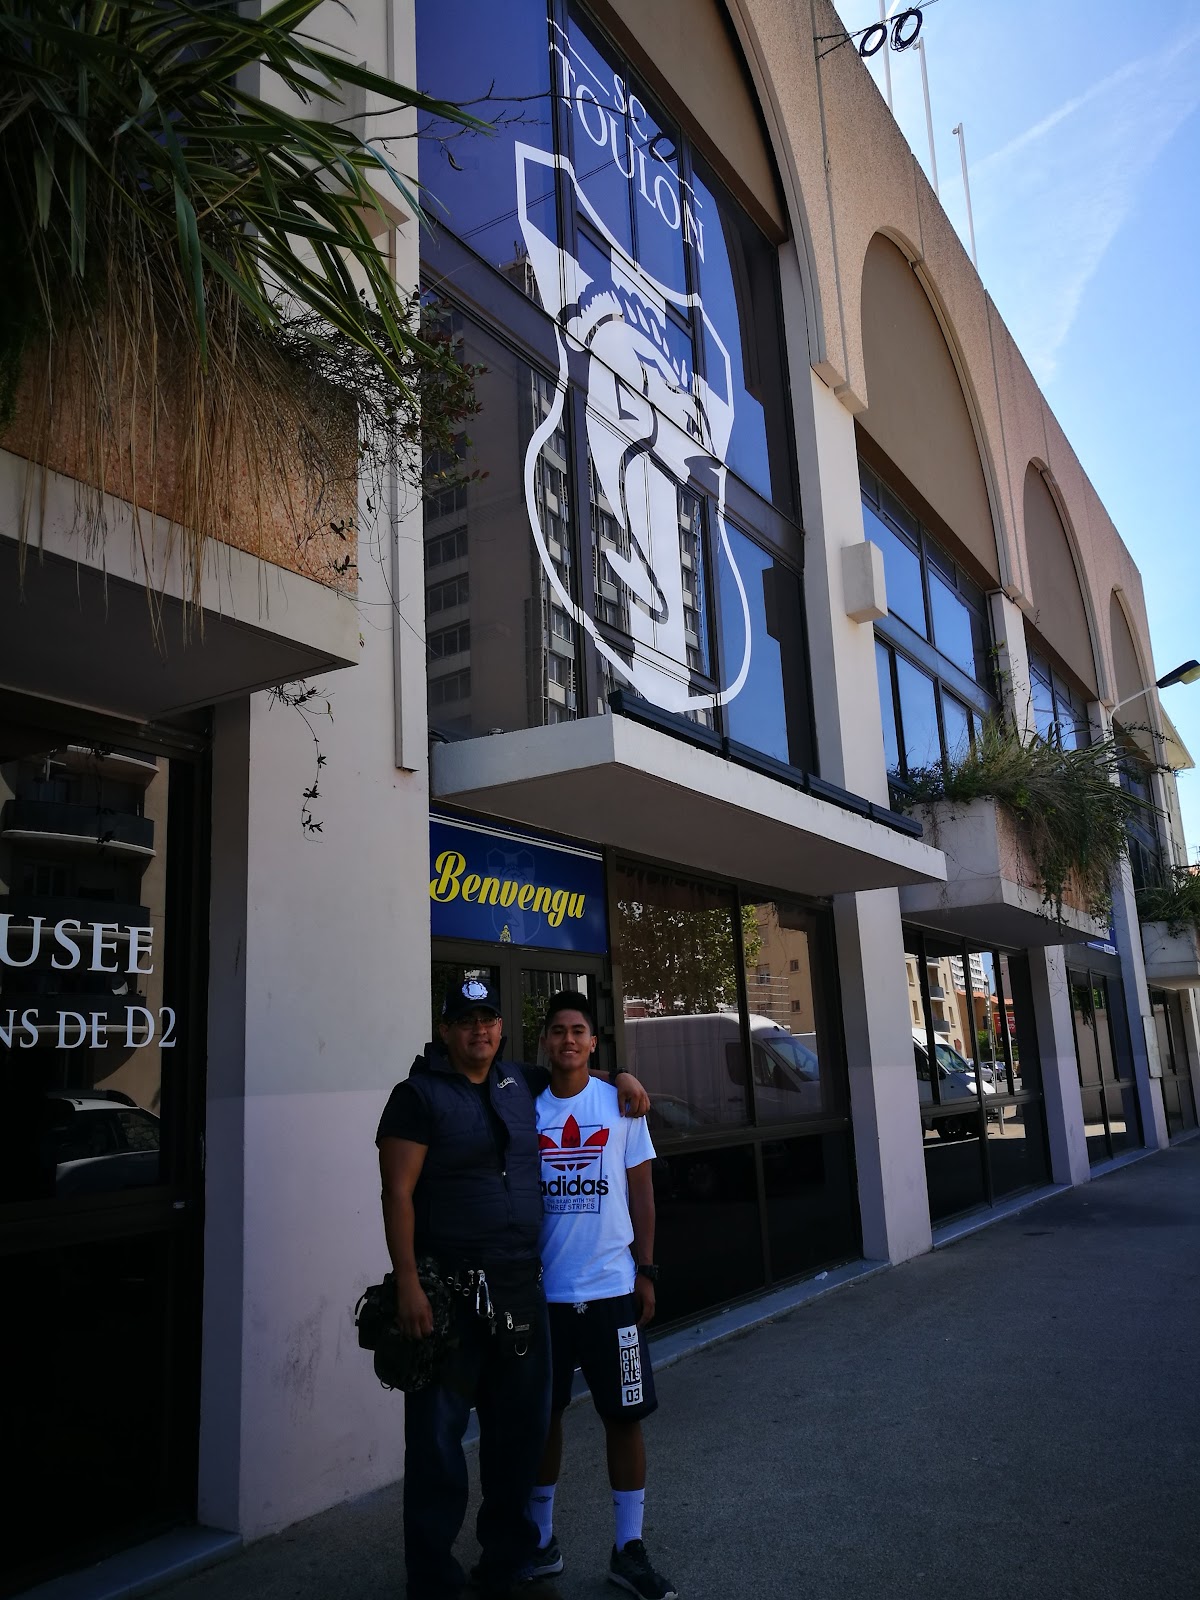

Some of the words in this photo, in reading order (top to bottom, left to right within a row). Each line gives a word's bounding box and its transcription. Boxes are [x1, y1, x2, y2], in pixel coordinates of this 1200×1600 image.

[549, 42, 705, 263] TOULON
[430, 851, 586, 927] Benvengu
[55, 1010, 109, 1049] DE
[123, 1005, 177, 1048] D2
[538, 1175, 608, 1196] adidas
[546, 1203, 566, 1211] THREE
[626, 1388, 640, 1403] 03
